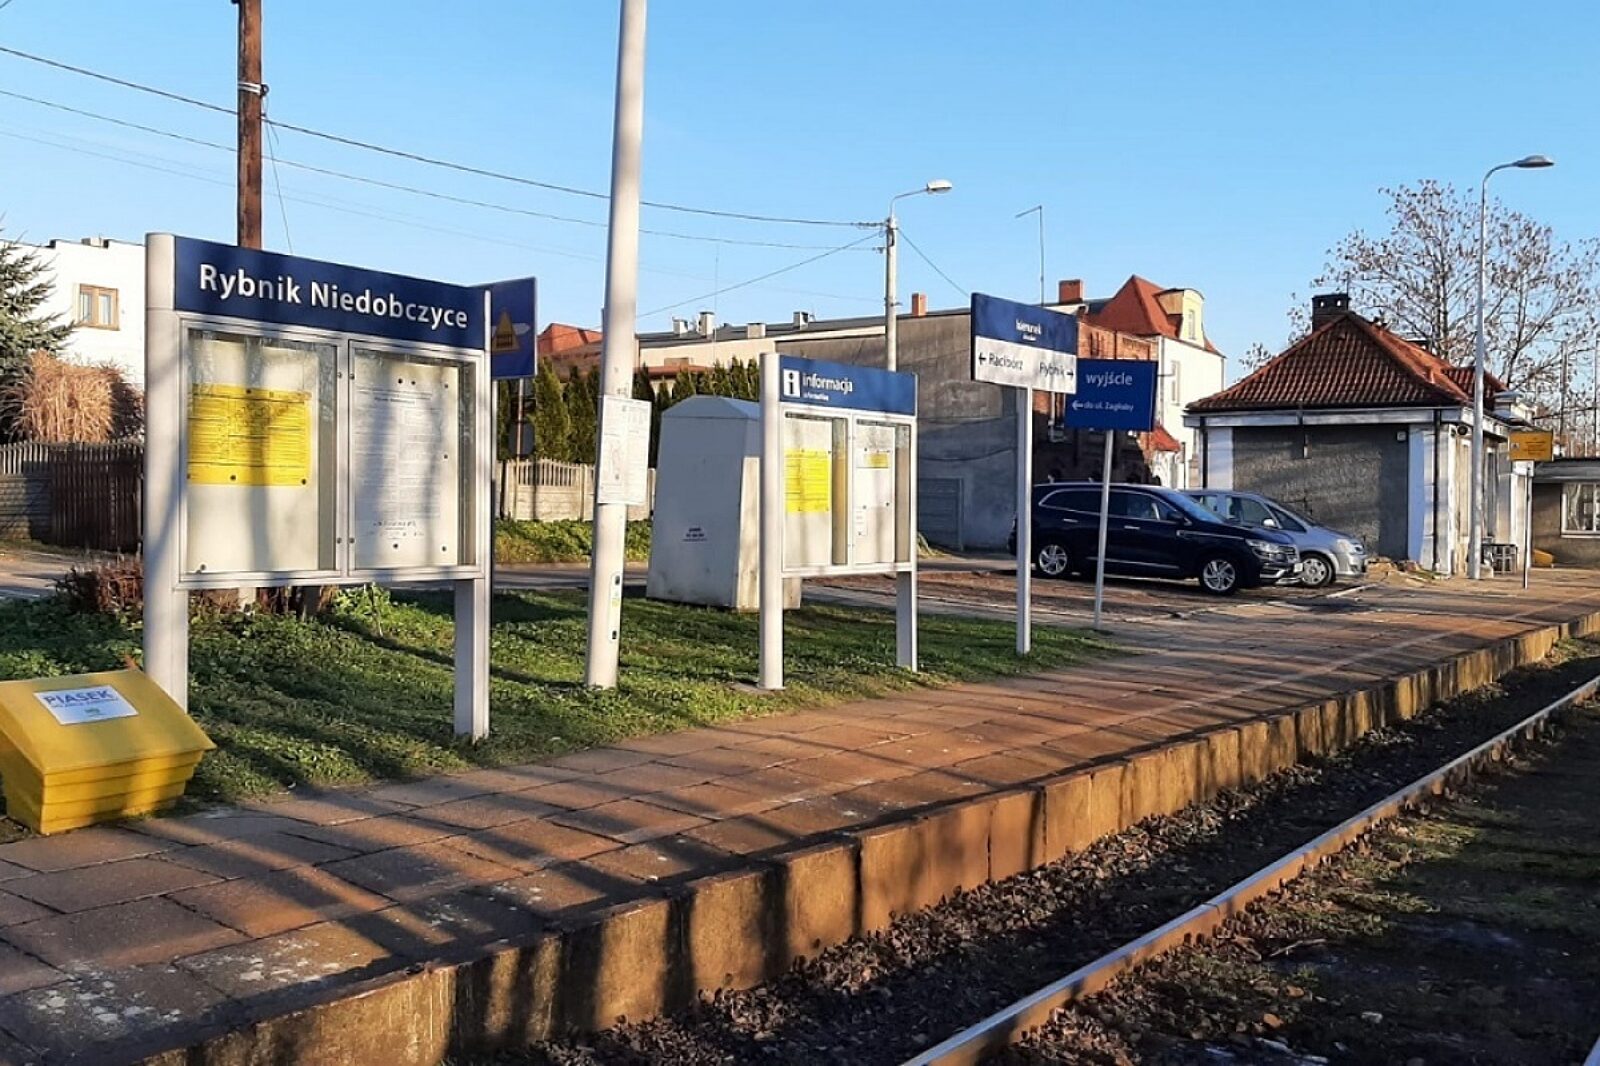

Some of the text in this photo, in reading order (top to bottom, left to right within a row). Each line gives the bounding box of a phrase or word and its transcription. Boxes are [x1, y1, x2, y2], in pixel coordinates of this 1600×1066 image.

[199, 262, 468, 330] Rybnik Niedobczyce
[802, 372, 853, 396] informacja
[1085, 371, 1133, 387] wyjście
[43, 690, 113, 704] PIASEK
